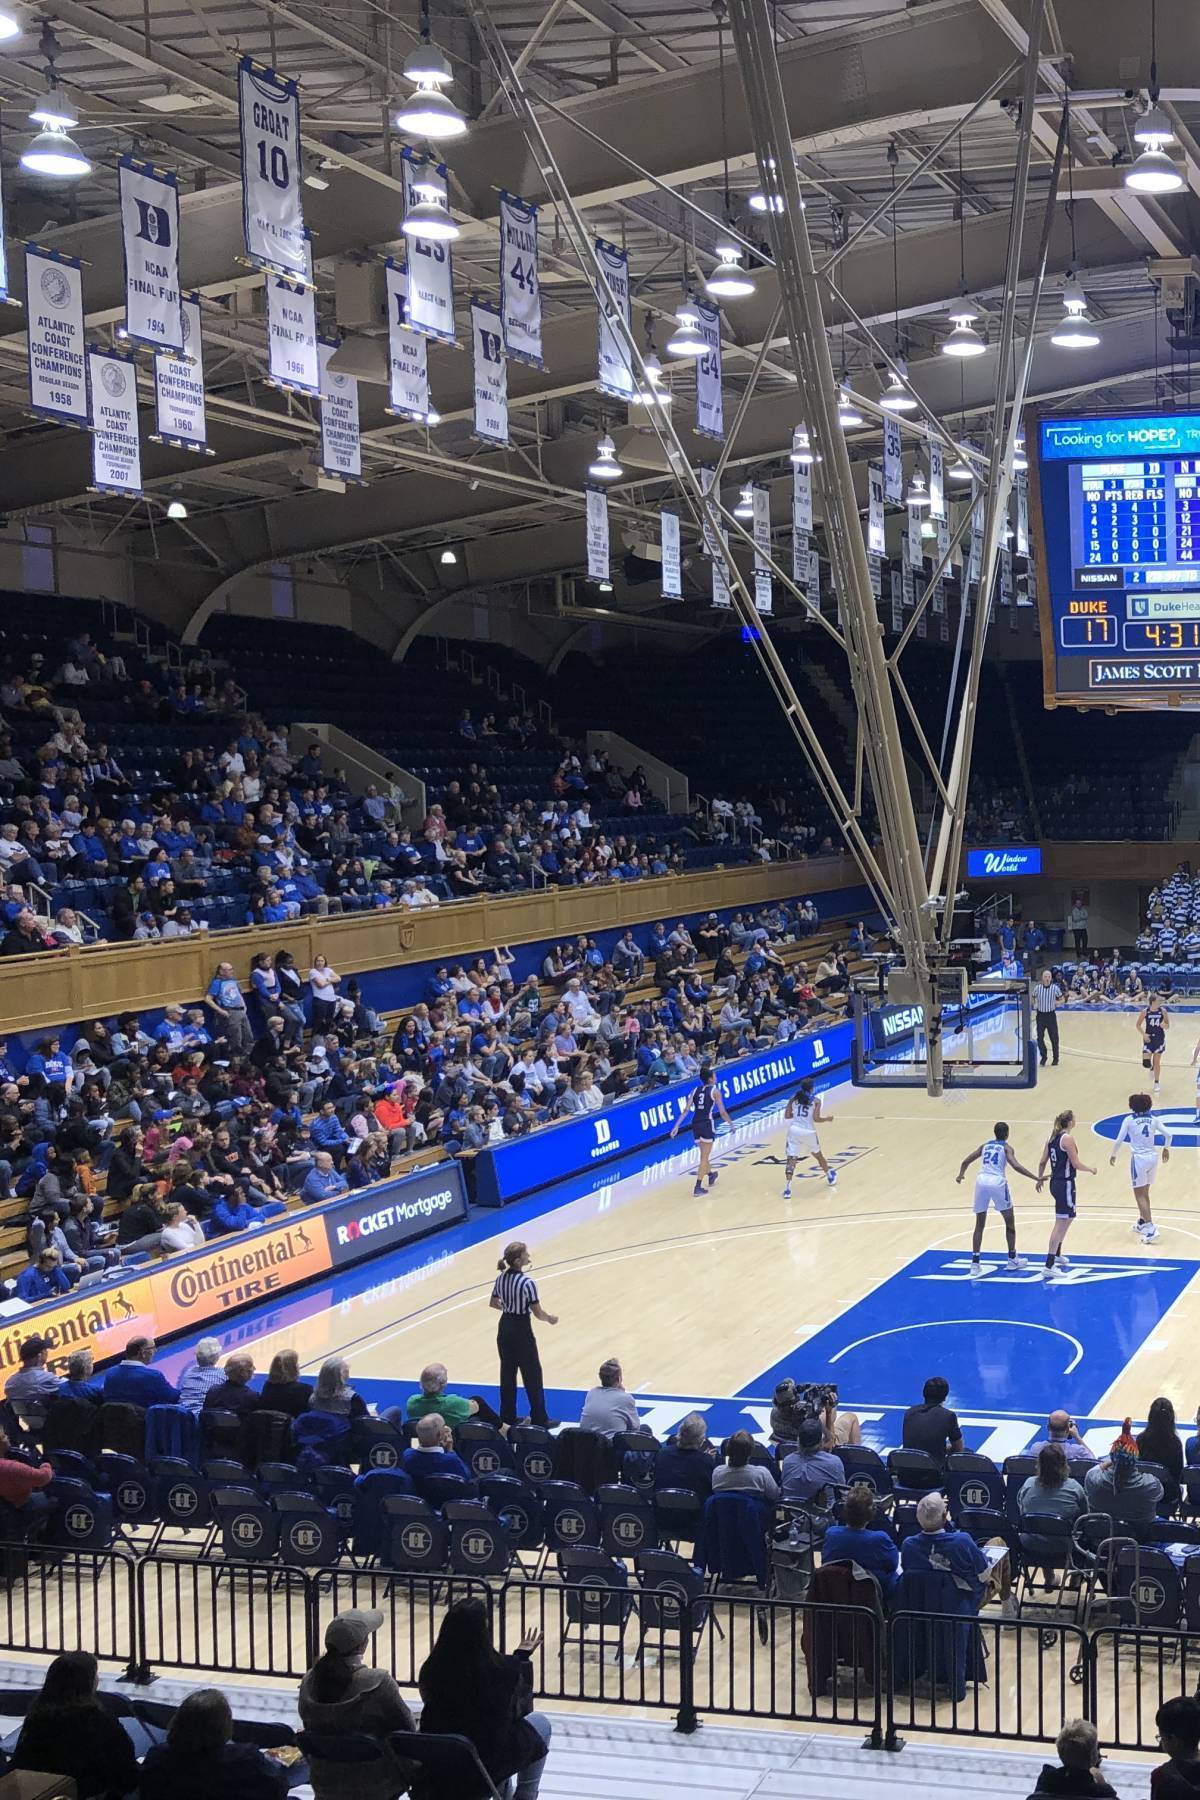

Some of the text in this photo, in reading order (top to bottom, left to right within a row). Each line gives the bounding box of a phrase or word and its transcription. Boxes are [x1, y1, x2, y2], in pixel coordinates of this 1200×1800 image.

[253, 102, 289, 142] GROAT
[257, 140, 289, 189] 10
[145, 260, 169, 279] NCAA
[511, 256, 534, 295] 44
[129, 279, 157, 298] FINAL
[282, 307, 303, 325] NCAA
[38, 317, 75, 336] ATLANTIC
[44, 332, 70, 347] COAST
[31, 343, 84, 366] CONFERENCE
[34, 356, 82, 379] CHAMPIONS
[169, 363, 191, 378] COAST
[287, 360, 304, 375] 1966
[159, 375, 203, 394] CONFERENCE
[49, 391, 72, 406] 1958
[161, 389, 202, 407] CHAMPIONS
[327, 394, 353, 410] ATLANTIC
[100, 406, 132, 421] ATLANTIC
[332, 407, 348, 419] COAST
[106, 418, 128, 431] COAST
[174, 417, 193, 432] 1960
[96, 430, 138, 446] CONFERENCE
[1054, 428, 1176, 448] Looking for HOPE?
[99, 442, 137, 458] CHAMPIONS
[1087, 489, 1163, 501] NO PTS REB FLS
[1179, 489, 1192, 498] NO
[1091, 504, 1097, 514] 3
[1111, 503, 1117, 513] 3
[1131, 503, 1137, 512] 4
[1183, 501, 1188, 510] 3
[1091, 517, 1097, 526] 4
[1112, 515, 1118, 525] 2
[1132, 515, 1138, 524] 3
[1181, 513, 1190, 523] 12
[1092, 527, 1159, 538] 5 2 2 0
[1182, 526, 1191, 535] 21
[1091, 539, 1159, 550] 15 0 0 0
[1181, 538, 1192, 547] 24
[1090, 553, 1101, 563] 24
[1112, 553, 1118, 562] 0
[1133, 552, 1139, 561] 0
[1181, 550, 1192, 560] 44
[1081, 574, 1117, 582] NISSAN
[1133, 573, 1139, 582] 2
[1070, 601, 1107, 614] DUKE
[1087, 619, 1108, 642] 17
[1146, 623, 1198, 648] 4:31
[1095, 664, 1140, 682] JAMES
[1143, 664, 1193, 679] SCOTT
[984, 853, 1027, 872] Window
[1150, 1018, 1160, 1027] 44
[640, 1056, 796, 1131] DUKE BASKETBALL
[699, 1093, 704, 1105] 3
[797, 1105, 808, 1118] 15
[1141, 1125, 1149, 1137] 4
[983, 1152, 999, 1165] 24
[337, 1190, 452, 1244] ROCKET Mortgage
[171, 1232, 296, 1308] Continental
[216, 1272, 280, 1307] TIRE
[0, 1298, 114, 1369] tiental
